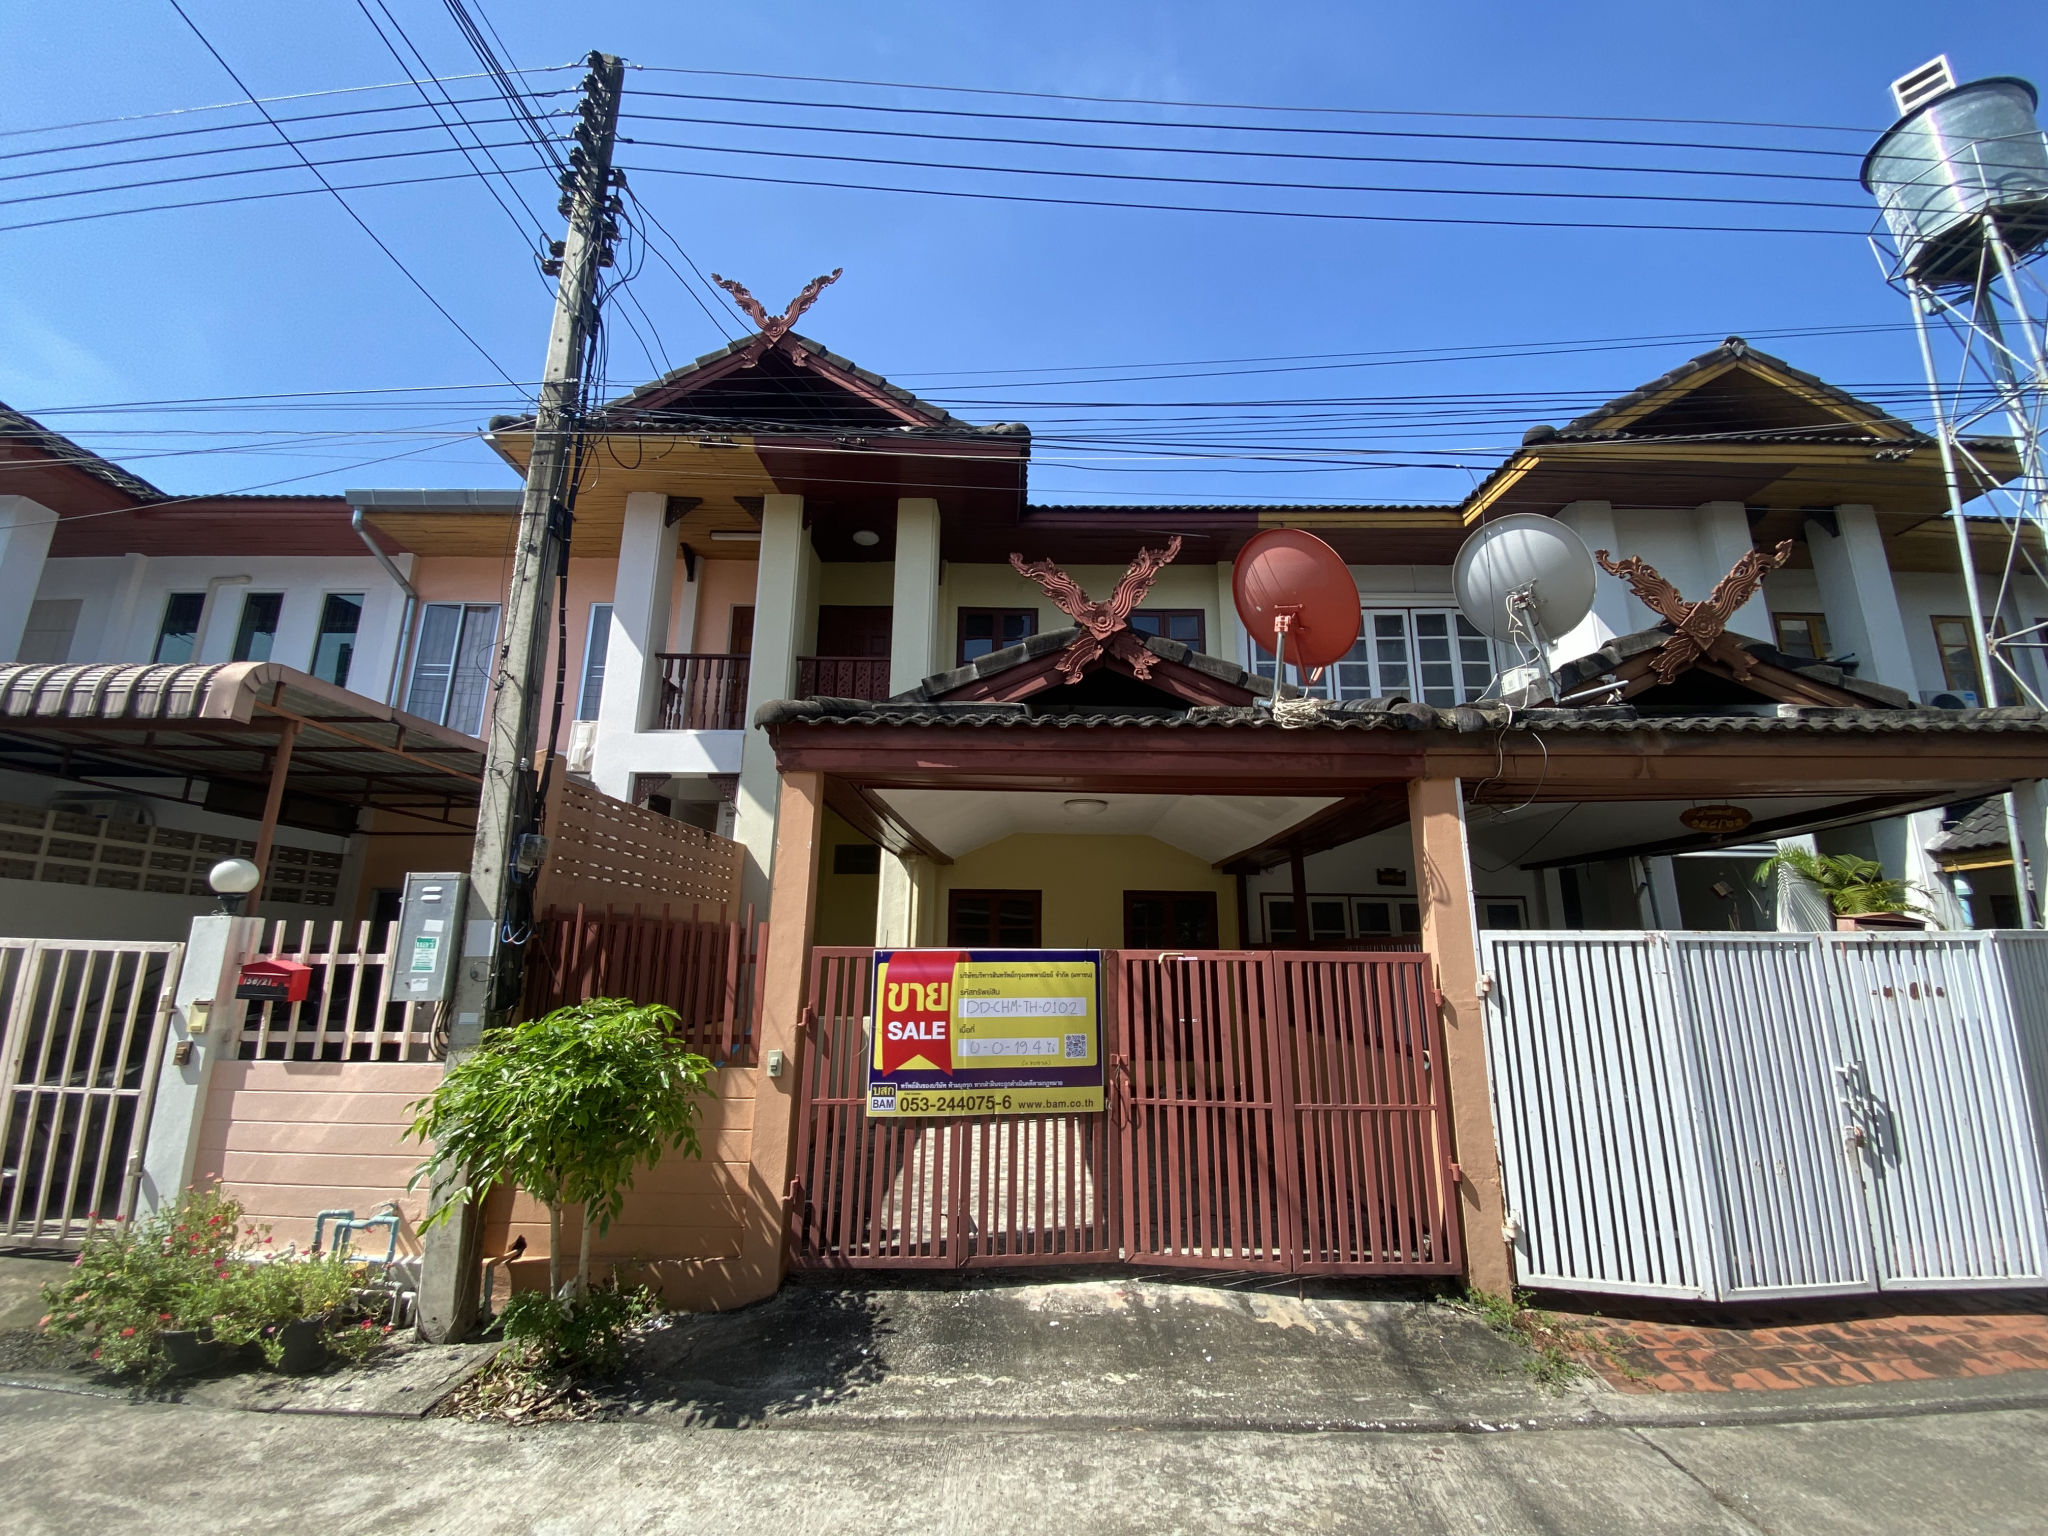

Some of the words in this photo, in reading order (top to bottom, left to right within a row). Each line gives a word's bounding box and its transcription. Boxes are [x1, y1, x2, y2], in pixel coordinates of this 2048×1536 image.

[888, 982, 949, 1012] ขาย
[960, 987, 1000, 996] รหัสทรัพย์สิน
[887, 1021, 946, 1041] SALE
[959, 1023, 976, 1034] เนื้อที่
[873, 1085, 895, 1096] บสก
[872, 1099, 894, 1109] BAM
[900, 1095, 1012, 1112] 053-244075-6
[1018, 1098, 1094, 1109] www.bam.co.th
